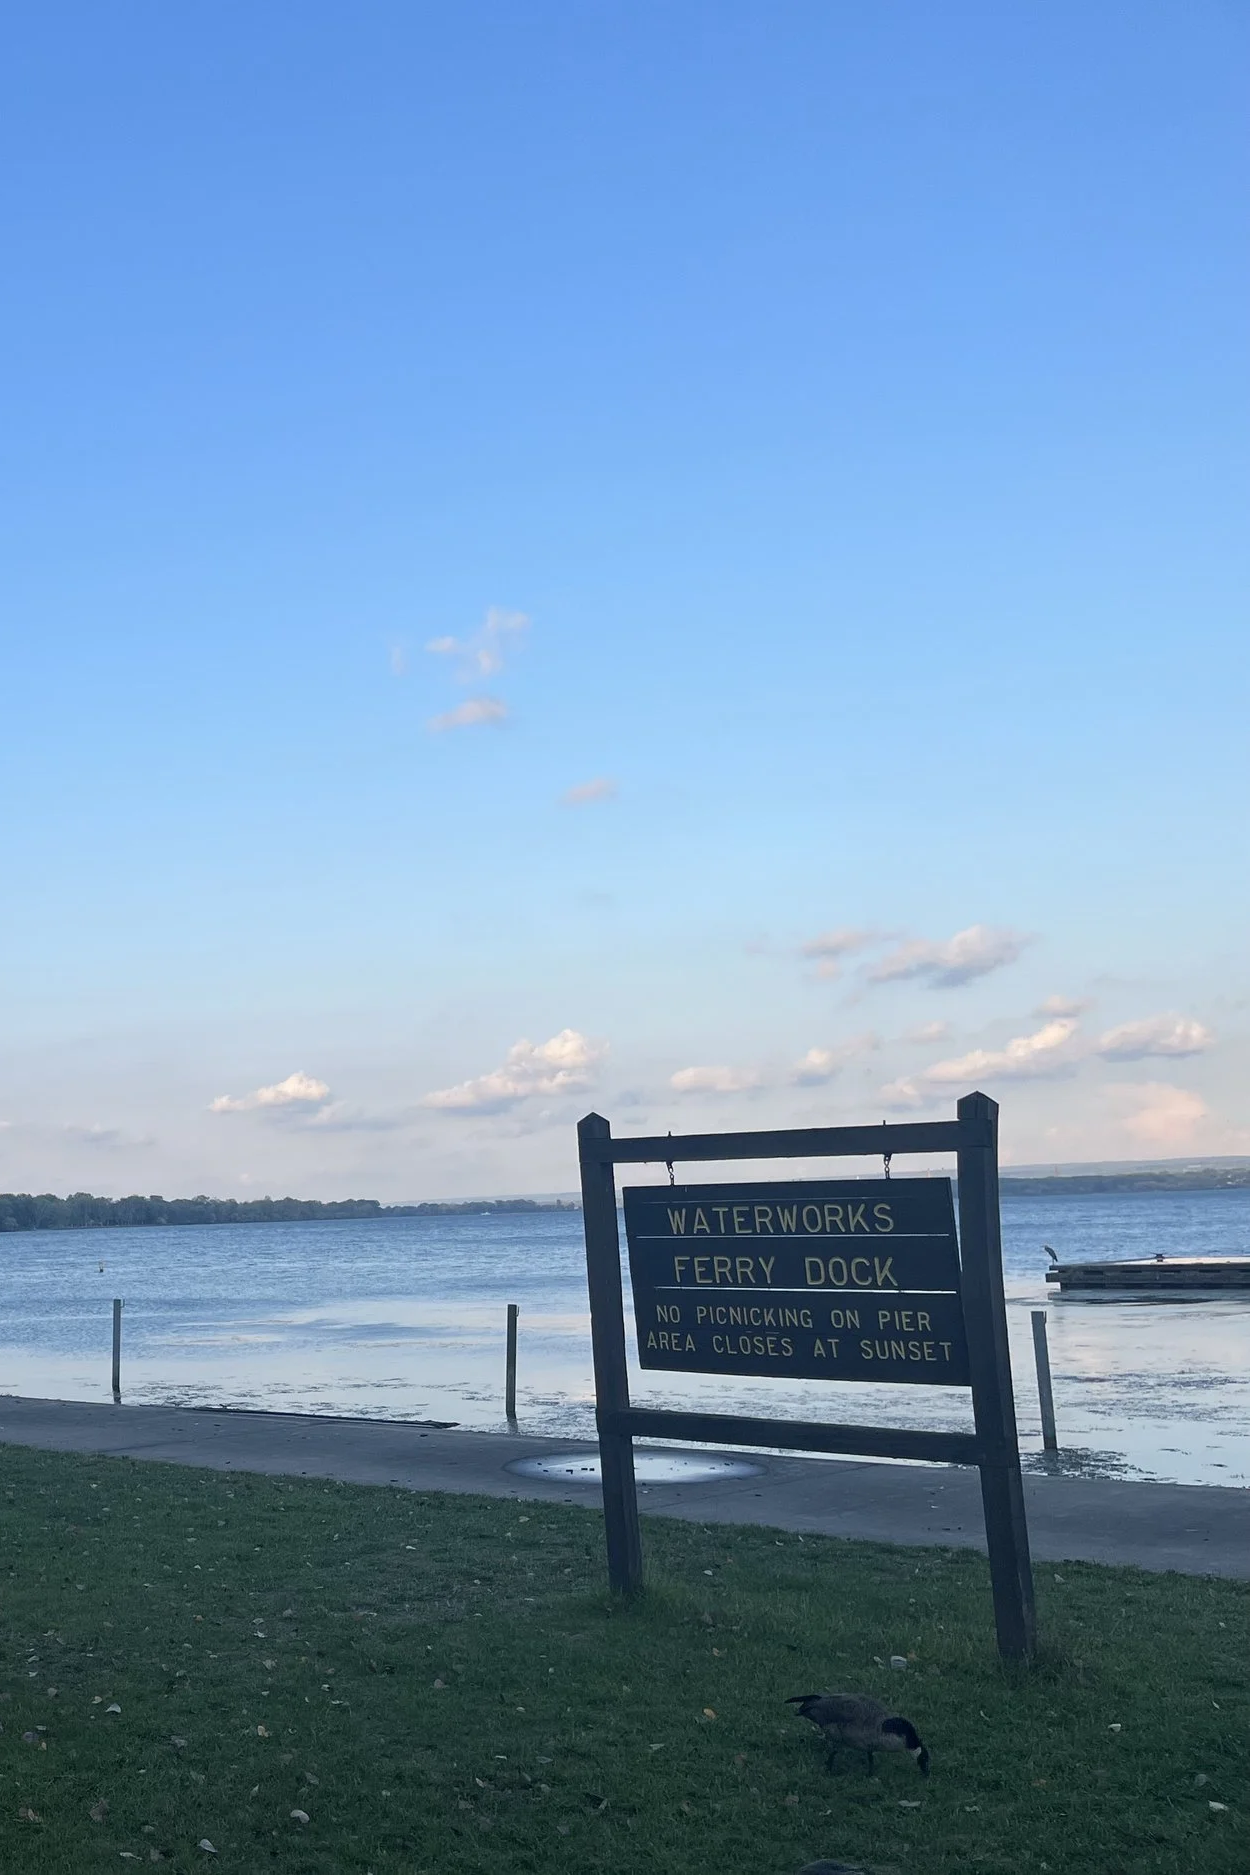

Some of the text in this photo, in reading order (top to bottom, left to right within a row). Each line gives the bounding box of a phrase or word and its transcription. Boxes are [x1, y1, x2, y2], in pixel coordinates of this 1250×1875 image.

[667, 1203, 894, 1234] WATERWORKS
[674, 1256, 898, 1286] FERRY DOCK
[656, 1305, 931, 1331] NO PICNICKING ON PIER
[647, 1332, 951, 1361] AREA CLOSES AT SUNSET
